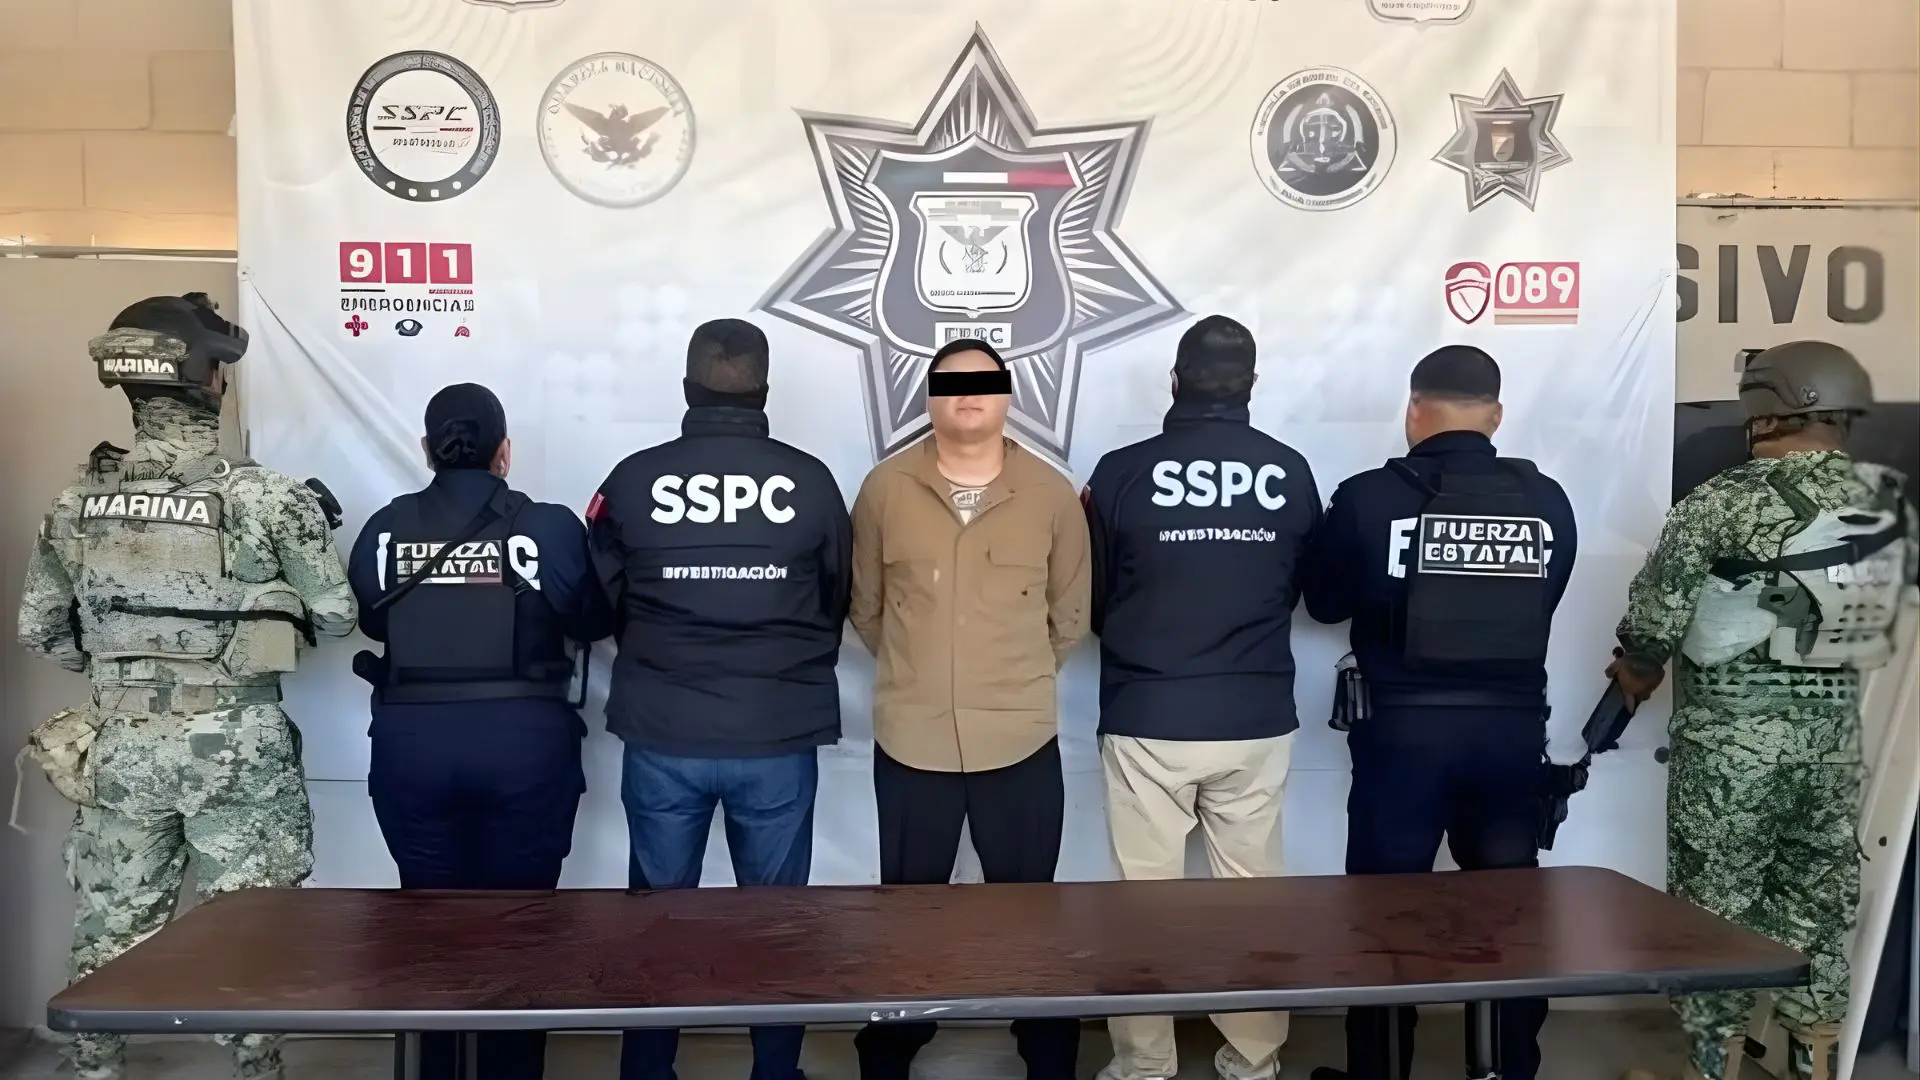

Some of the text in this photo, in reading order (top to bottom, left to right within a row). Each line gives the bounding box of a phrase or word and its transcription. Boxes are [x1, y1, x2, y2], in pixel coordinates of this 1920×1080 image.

[349, 248, 458, 279] 911
[1498, 265, 1575, 304] 089
[650, 474, 796, 524] SSPC
[1151, 460, 1287, 511] SSPC
[82, 494, 211, 524] MARINA
[1433, 521, 1533, 541] FUERZA
